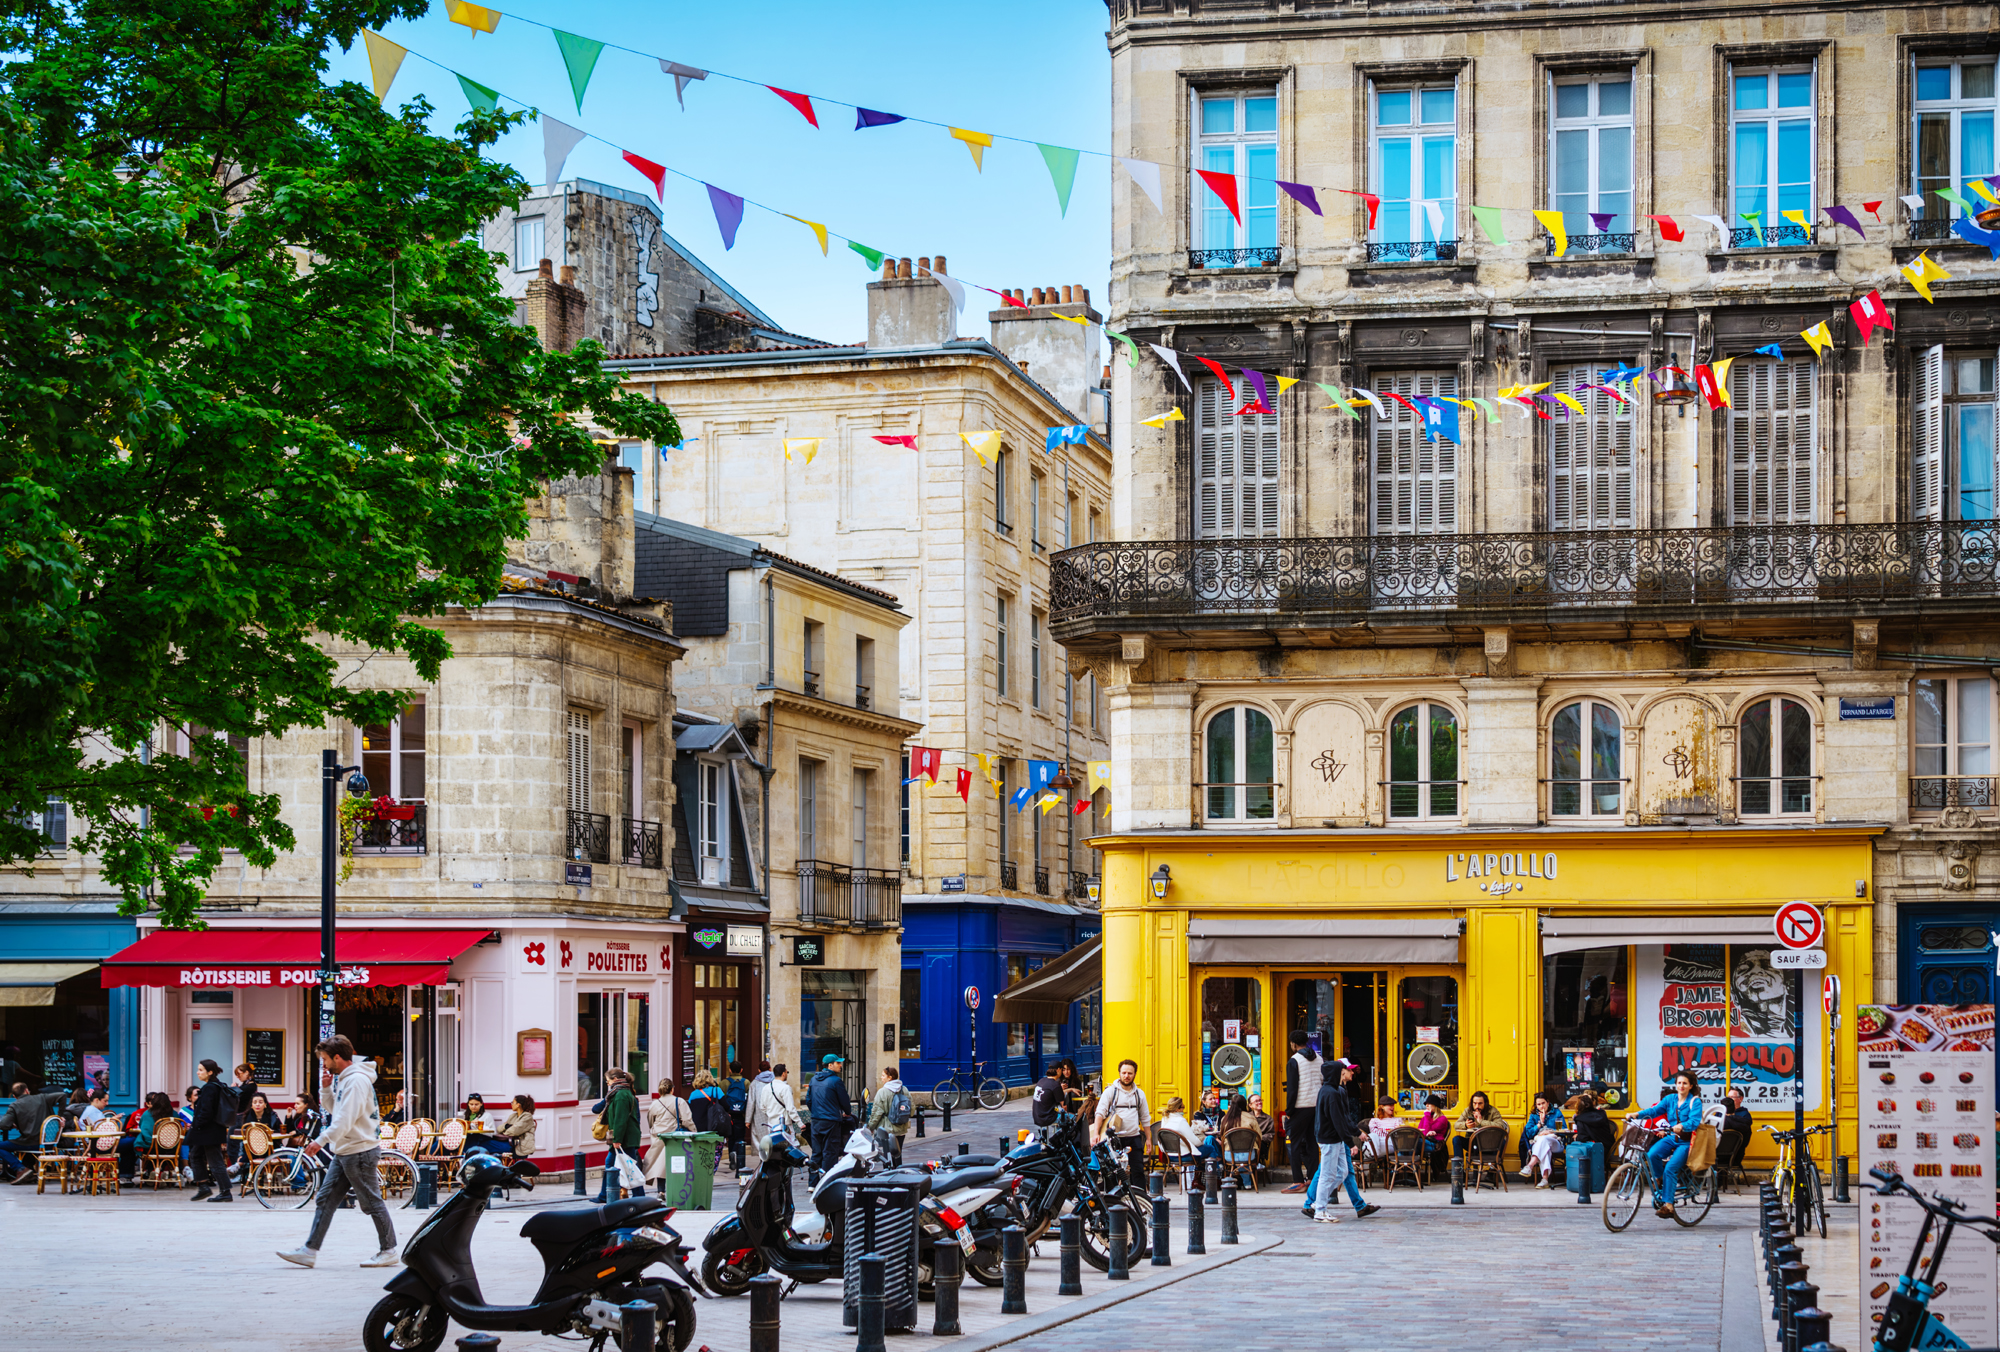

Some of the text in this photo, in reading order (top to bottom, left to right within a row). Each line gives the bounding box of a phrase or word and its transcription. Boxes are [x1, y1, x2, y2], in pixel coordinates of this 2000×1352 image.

[1446, 852, 1557, 883] L'APOLLO
[1955, 867, 1964, 875] 19
[730, 934, 761, 947] DU CHALET
[588, 952, 647, 972] POULETTES
[180, 967, 271, 984] RÔTISSERIE
[1662, 1005, 1740, 1028] BROWN
[1699, 1045, 1795, 1078] APOLLO
[1758, 1086, 1779, 1098] 28
